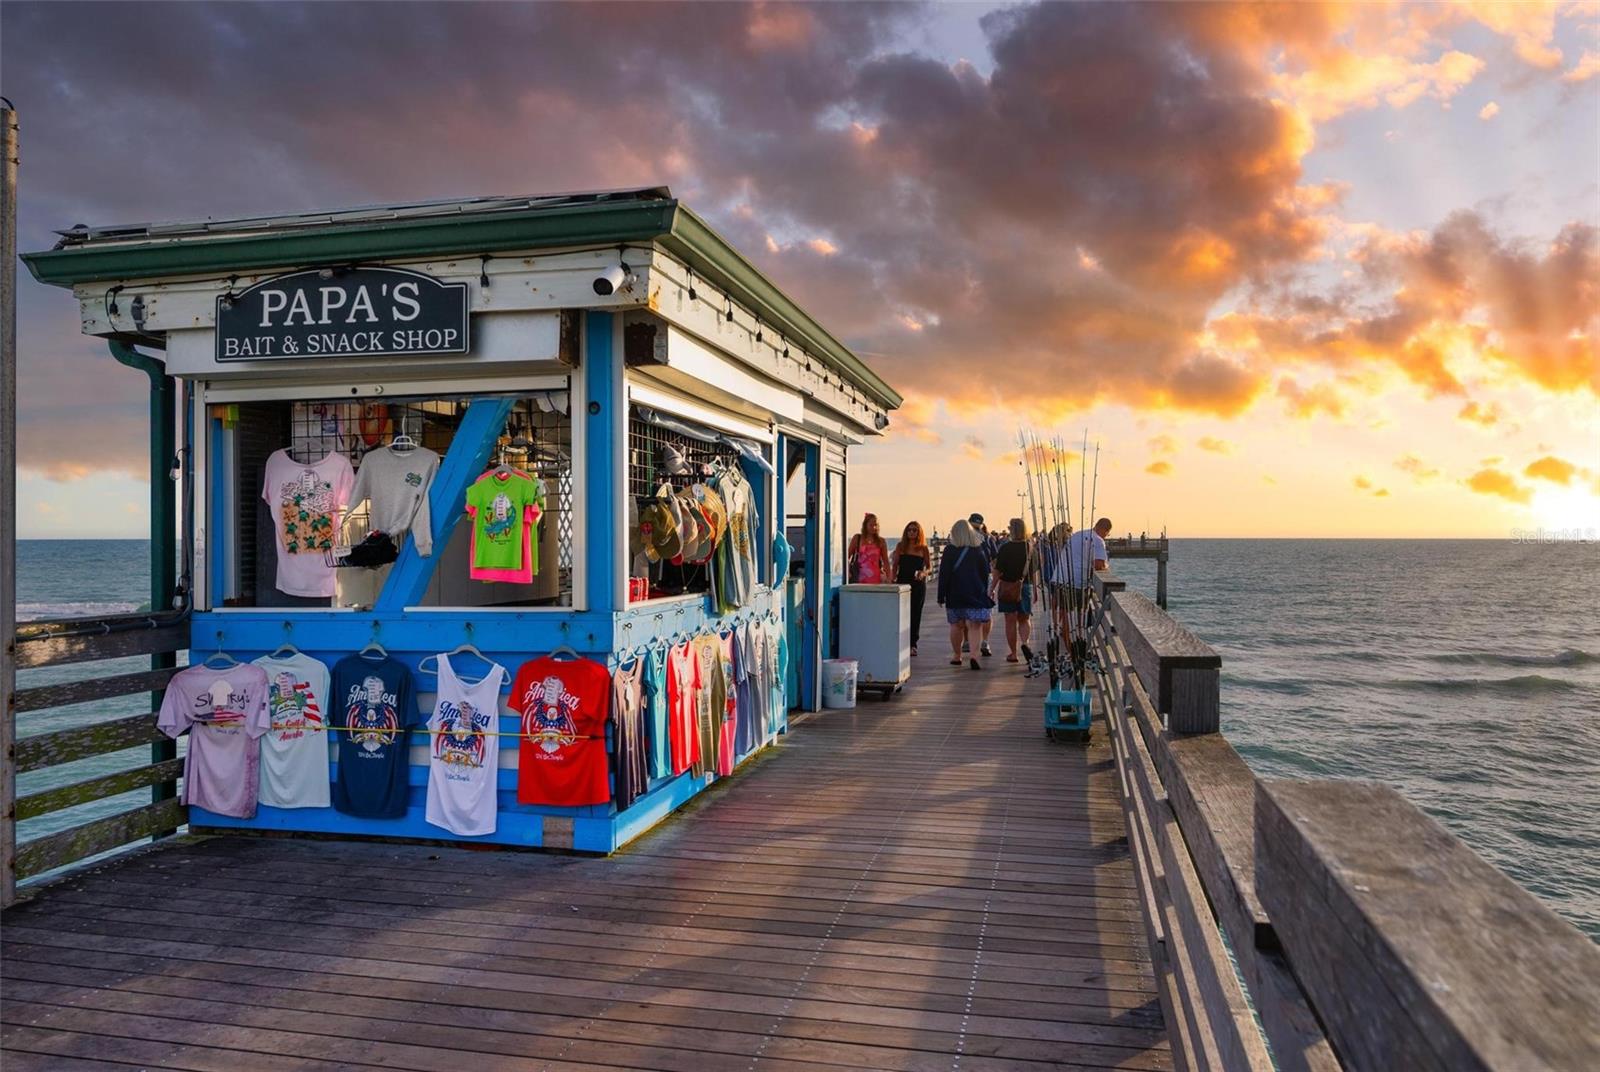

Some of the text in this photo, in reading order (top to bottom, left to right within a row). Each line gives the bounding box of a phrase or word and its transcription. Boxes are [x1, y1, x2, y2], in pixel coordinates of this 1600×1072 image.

[258, 282, 421, 328] PAPA'S
[224, 328, 458, 357] BAIT & SNACK SHOP
